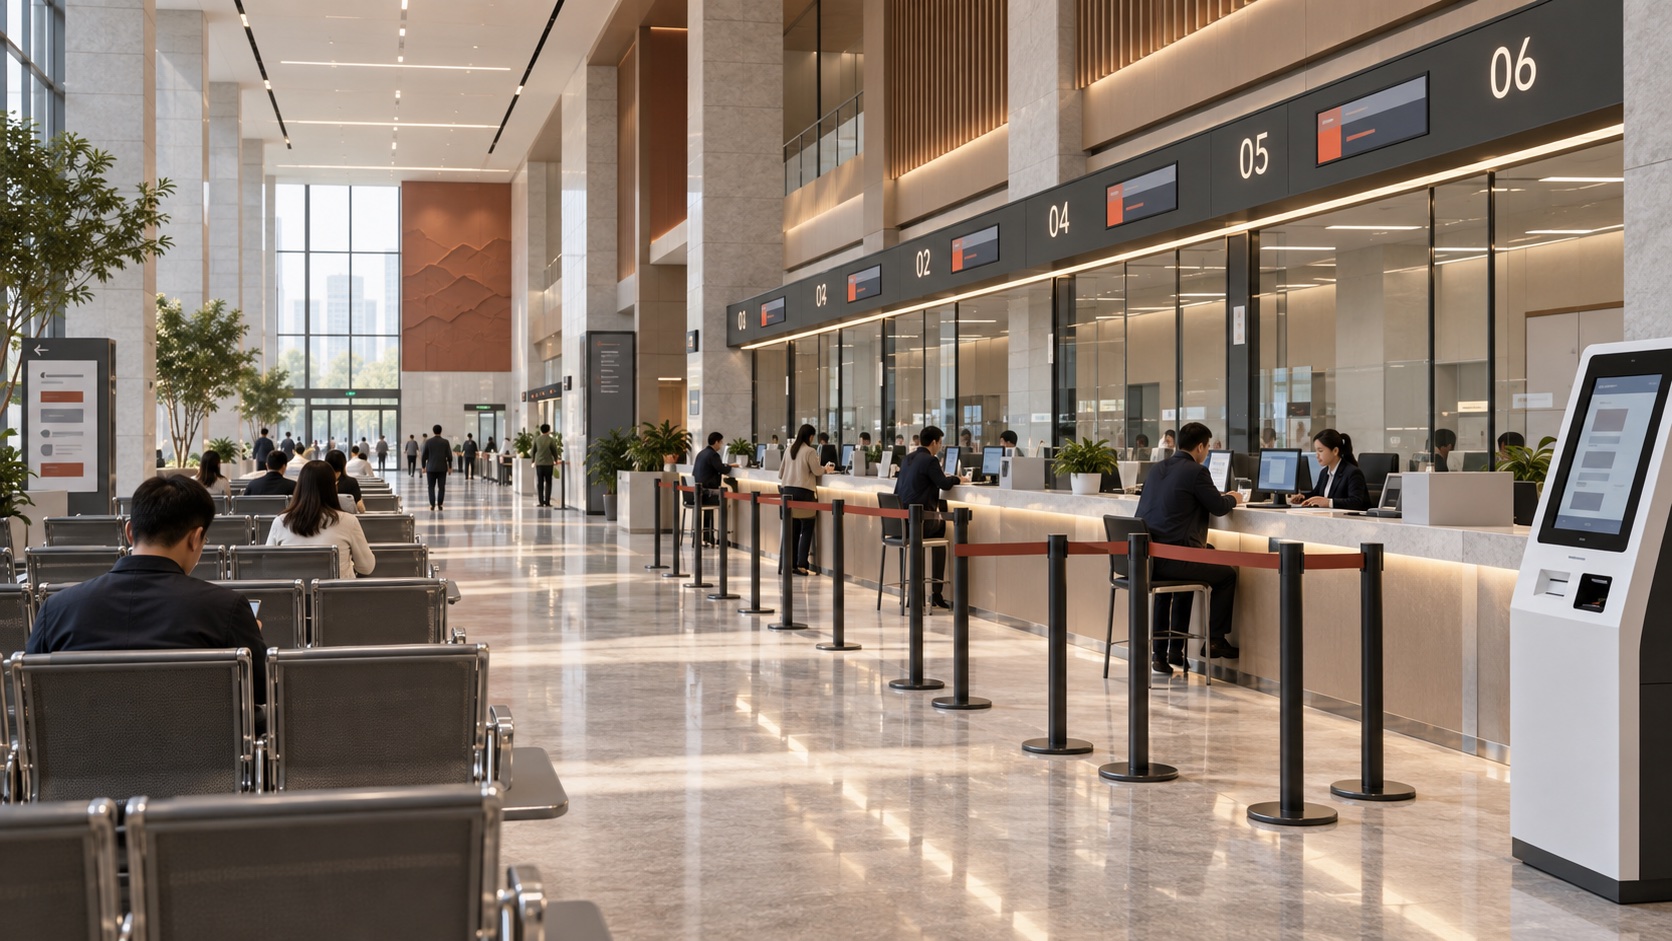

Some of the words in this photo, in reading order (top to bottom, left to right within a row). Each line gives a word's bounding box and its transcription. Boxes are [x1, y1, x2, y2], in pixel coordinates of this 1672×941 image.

[1490, 36, 1538, 99] 06
[1239, 131, 1269, 180] 05
[1049, 201, 1069, 237] 04
[916, 248, 931, 278] 02
